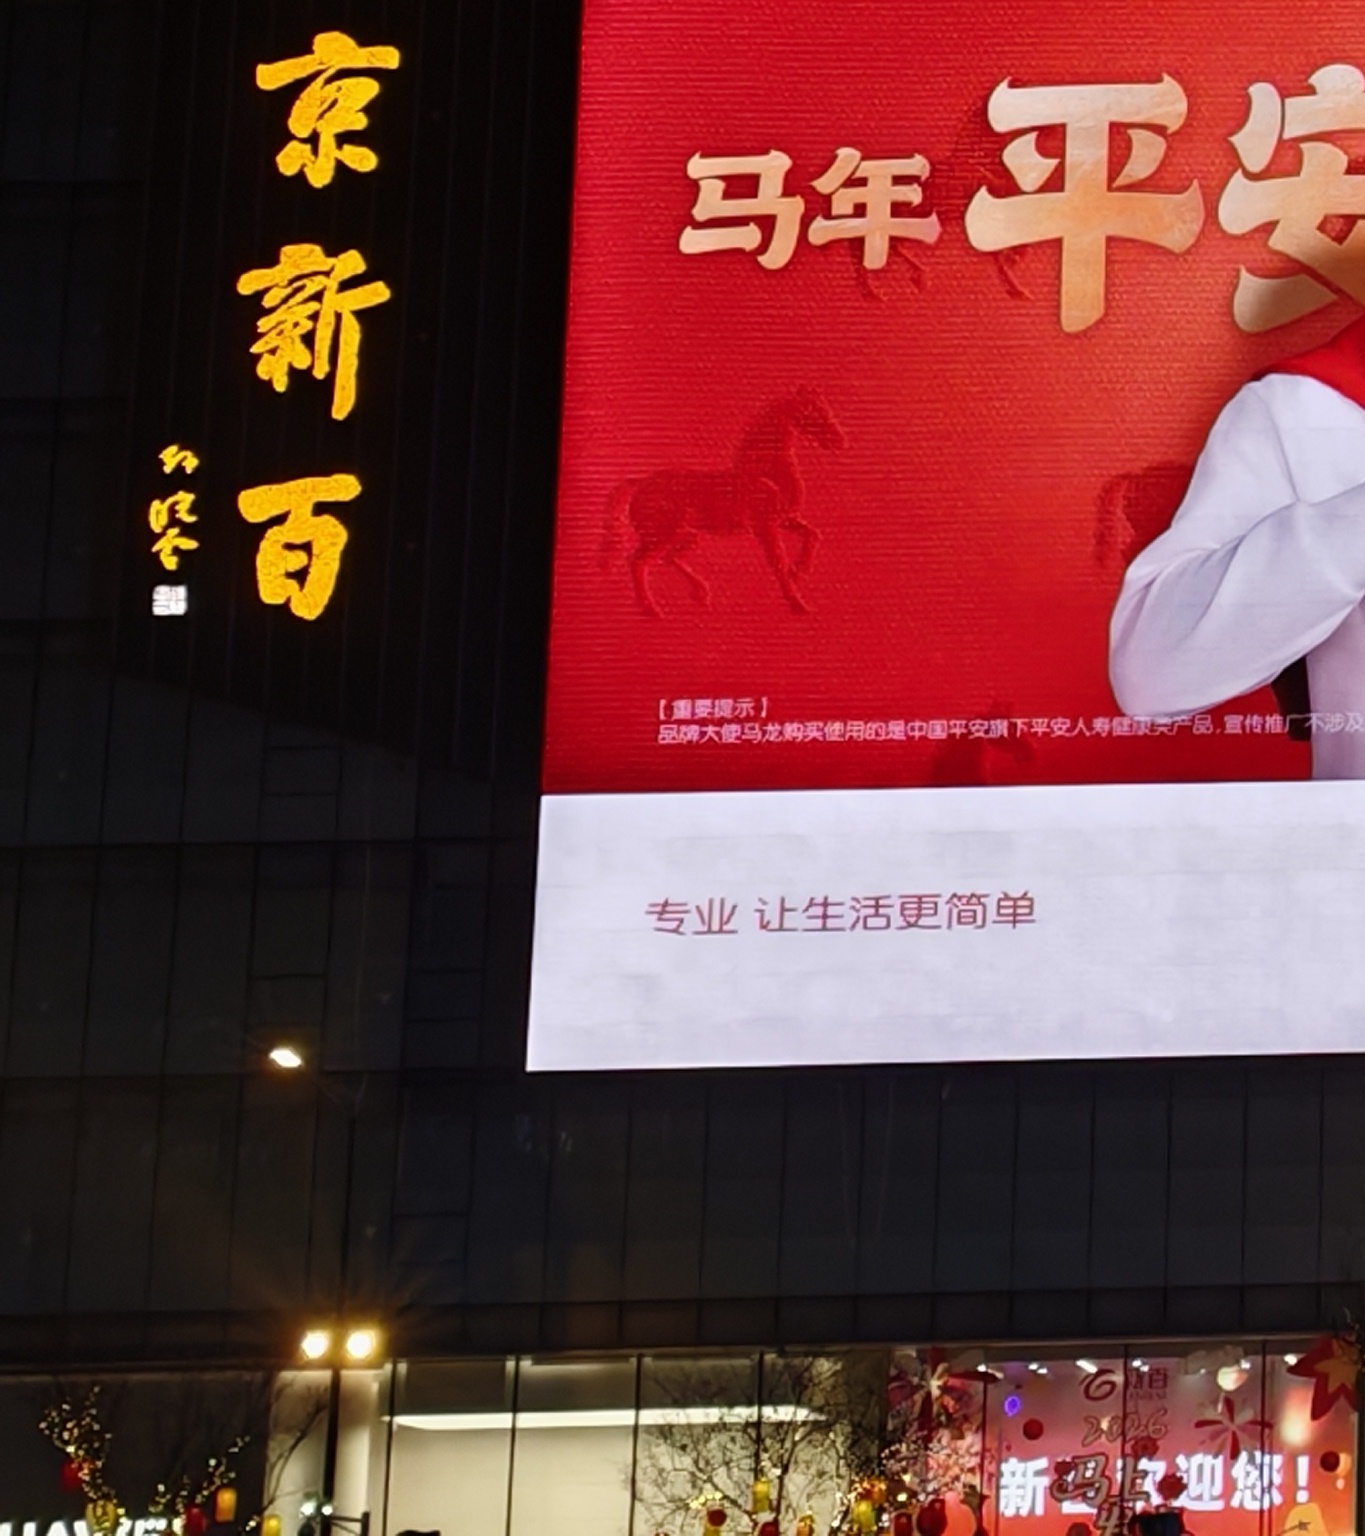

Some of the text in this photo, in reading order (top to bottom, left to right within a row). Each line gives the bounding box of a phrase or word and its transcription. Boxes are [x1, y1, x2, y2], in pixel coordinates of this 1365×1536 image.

[645, 889, 1037, 937] 专业 让生活更简单
